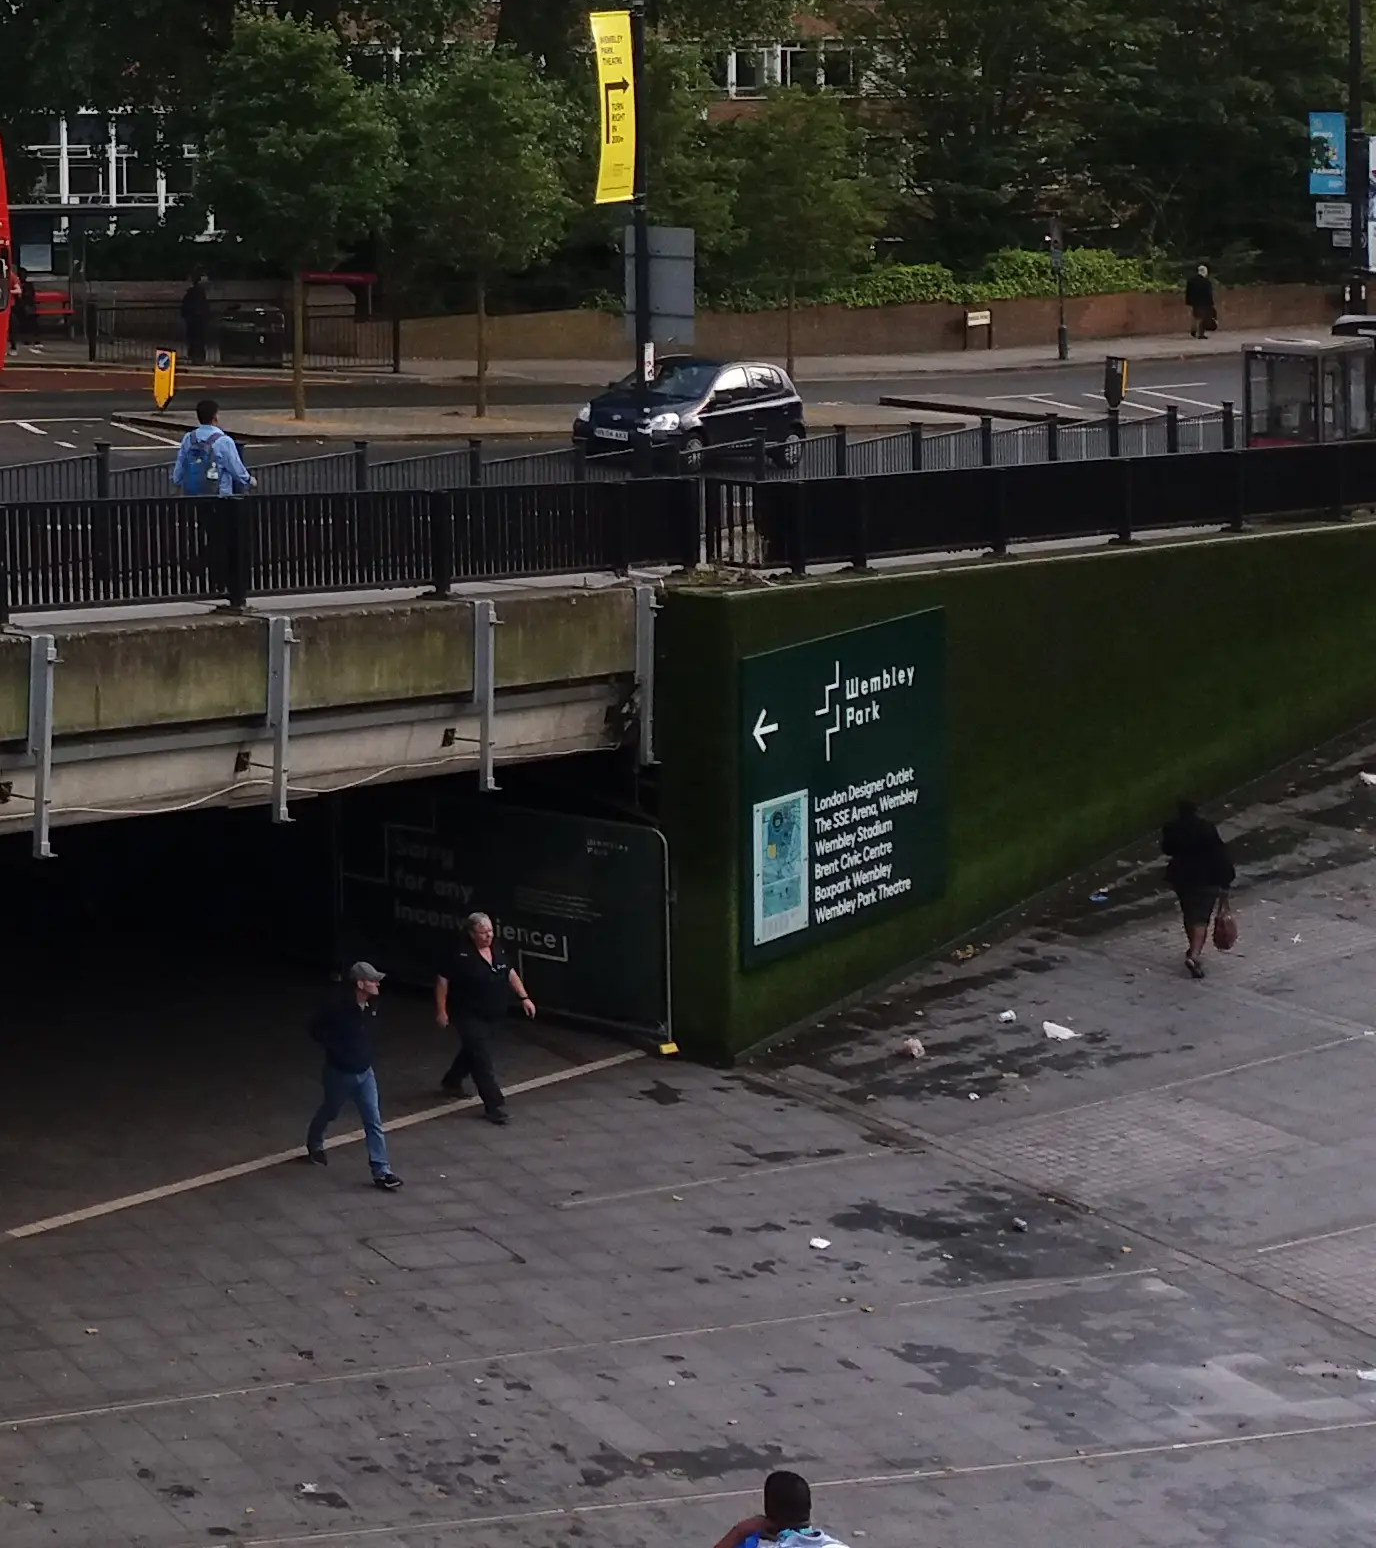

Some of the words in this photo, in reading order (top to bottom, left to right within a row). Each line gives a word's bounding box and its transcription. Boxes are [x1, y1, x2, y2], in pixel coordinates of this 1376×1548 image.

[603, 57, 622, 65] THEATRE
[846, 666, 915, 700] Wembley
[846, 701, 880, 728] Park
[815, 788, 847, 812] London
[848, 776, 885, 802] Designer
[886, 767, 914, 788] Outlet
[815, 818, 831, 834] The
[832, 812, 850, 829] SSE
[851, 803, 878, 823] Arena,
[879, 787, 919, 813] Wembley
[395, 837, 454, 870] Sorry
[815, 832, 855, 856] Wembley
[857, 820, 893, 842] Stadium
[815, 862, 838, 880] Brent
[840, 852, 862, 871] Civic
[863, 841, 893, 864] Centre
[393, 869, 426, 890] for
[433, 882, 474, 904] any
[815, 877, 852, 902] Boxpark
[852, 862, 892, 891] Wembley
[815, 899, 856, 924] Wembley
[858, 890, 877, 910] Park
[878, 878, 912, 900] Theatre
[394, 898, 557, 950] inconvience
